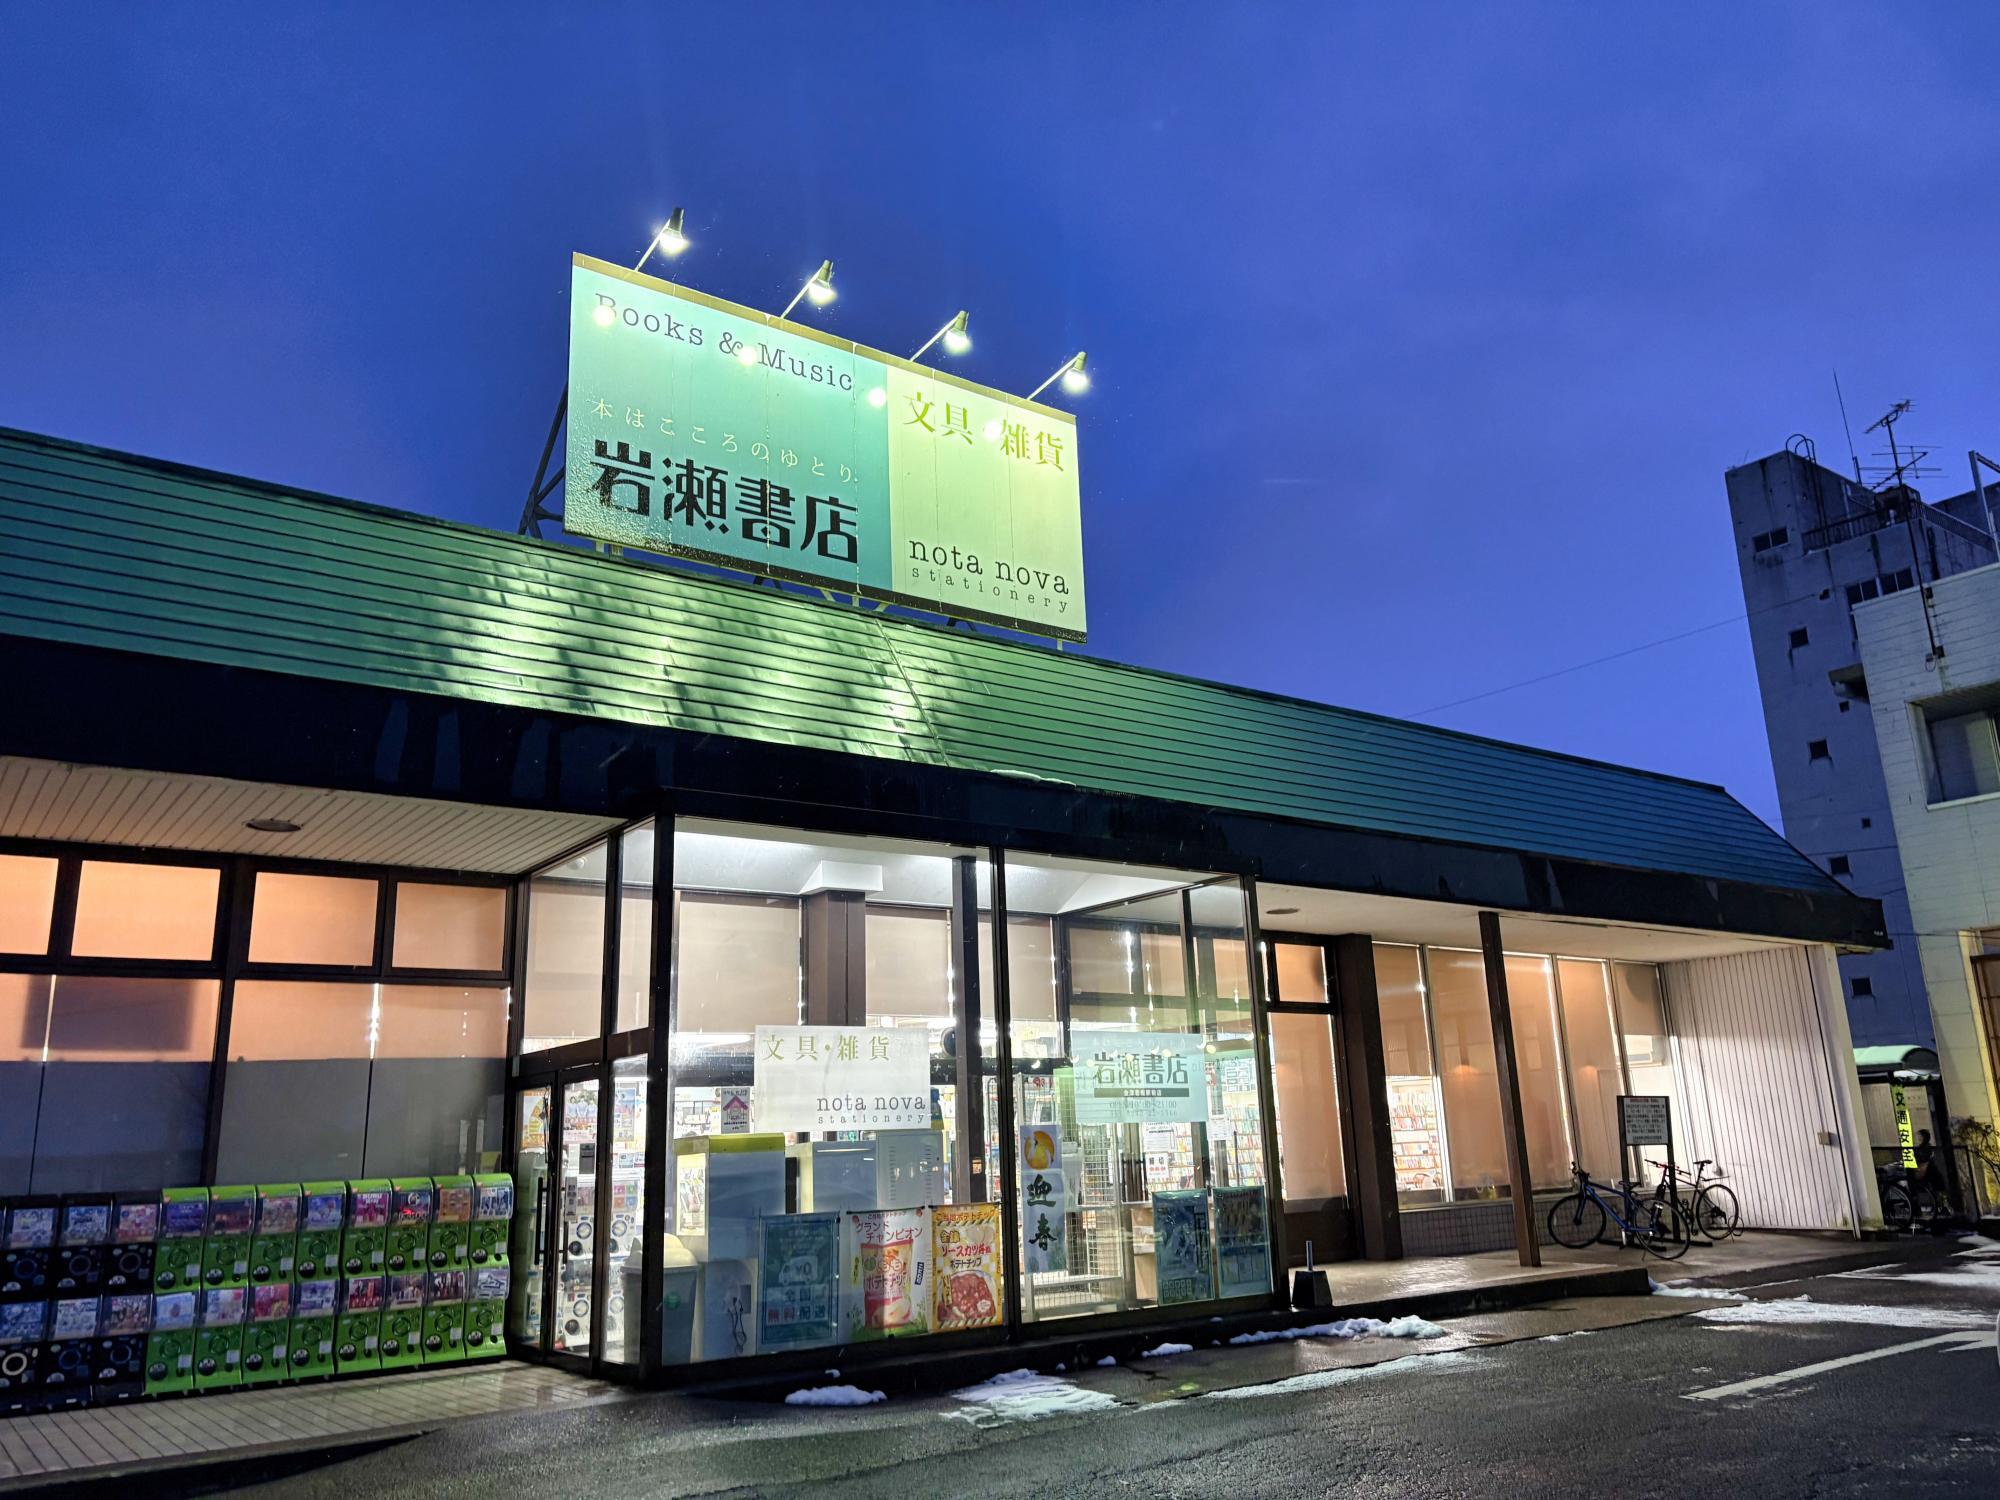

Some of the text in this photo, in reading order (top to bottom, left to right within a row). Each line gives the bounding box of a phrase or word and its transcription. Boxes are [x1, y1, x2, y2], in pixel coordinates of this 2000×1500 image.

[595, 293, 853, 391] Books & Music
[587, 397, 852, 483] 本はこころのゆとり
[903, 391, 974, 446] 文具
[589, 438, 858, 564] 岩瀬書店
[909, 539, 1069, 595] nota nova
[912, 567, 1068, 614] stationery
[762, 1034, 890, 1062] 文具・雑貨
[1093, 1051, 1189, 1085] 岩瀬書店
[816, 1093, 926, 1112] nota nova
[818, 1113, 925, 1125] stationery
[1895, 1091, 1914, 1162] 交通安全
[855, 1221, 890, 1233] グランド
[866, 1227, 923, 1243] チャンピオン
[1026, 1173, 1058, 1251] 迎春
[949, 1257, 982, 1269] ポテトチップ
